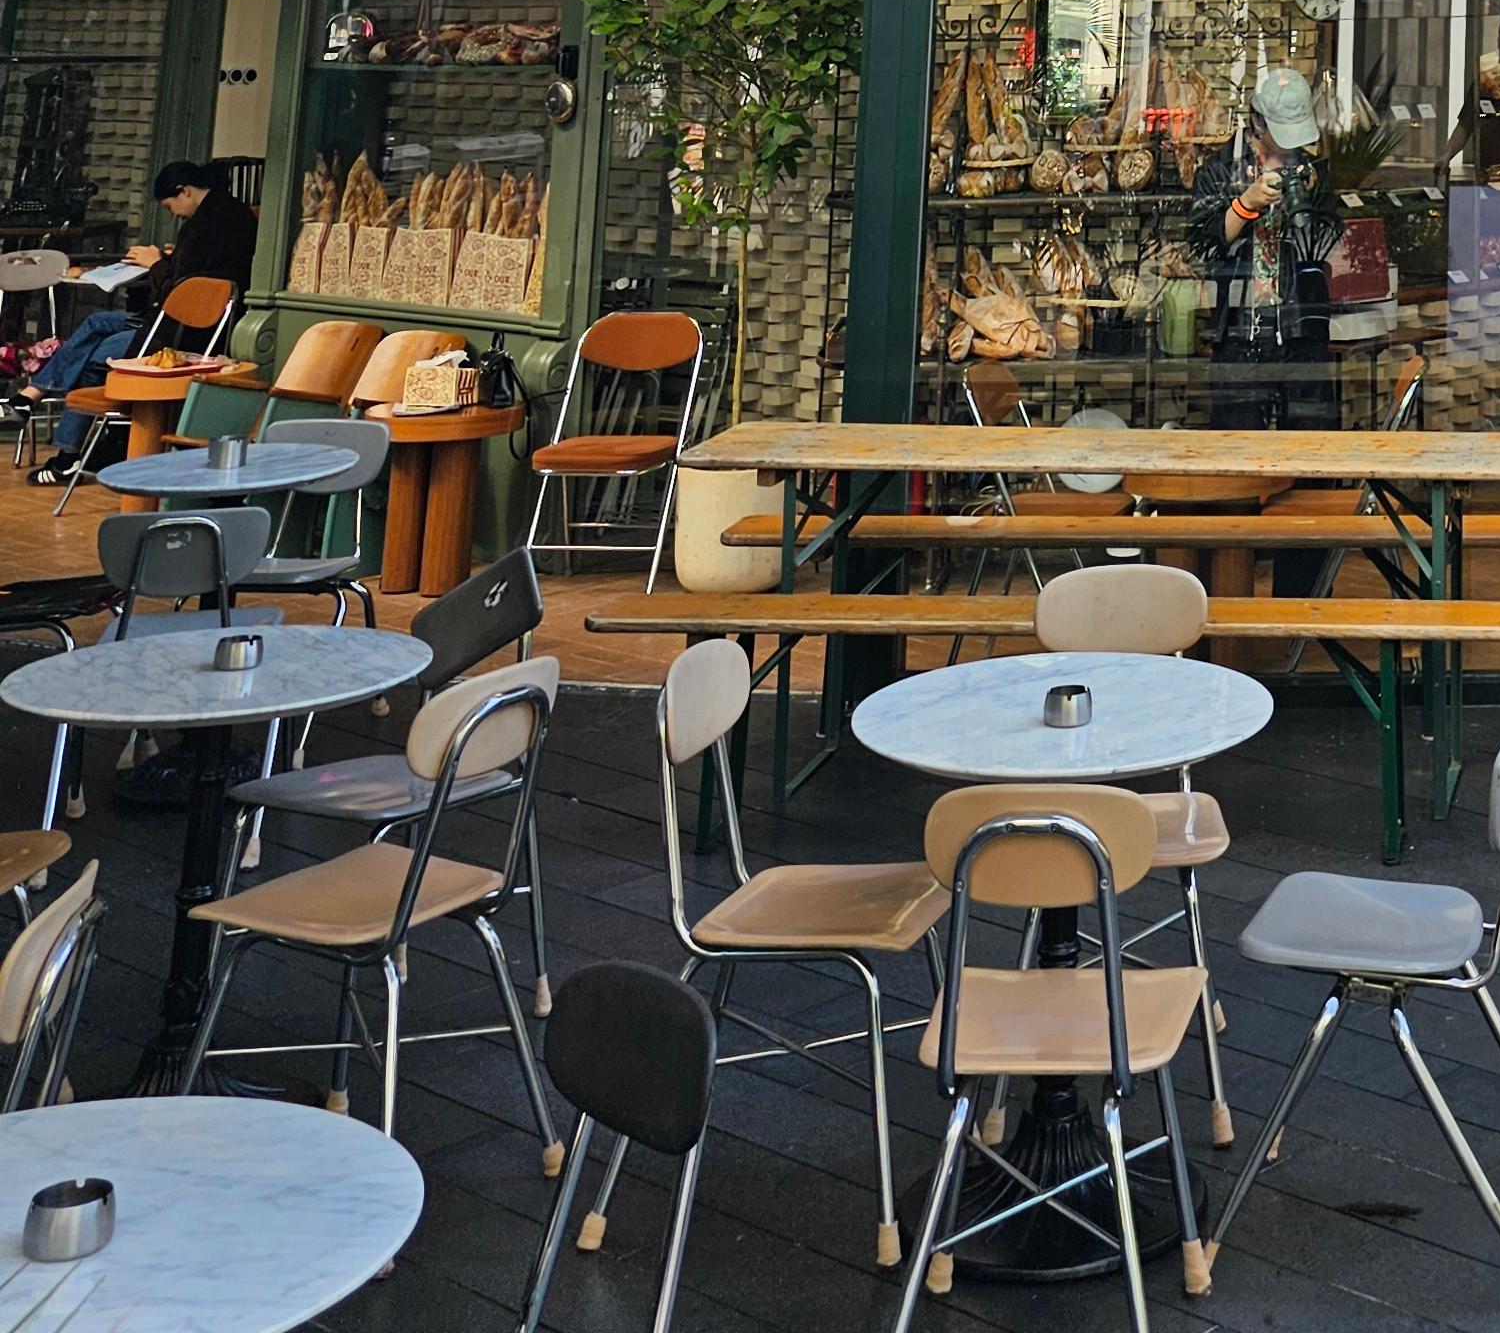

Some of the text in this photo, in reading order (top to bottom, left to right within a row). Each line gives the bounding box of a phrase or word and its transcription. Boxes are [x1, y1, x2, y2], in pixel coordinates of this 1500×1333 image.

[1312, 6, 1318, 17] 6
[1325, 5, 1331, 16] 5
[493, 274, 510, 283] OUR
